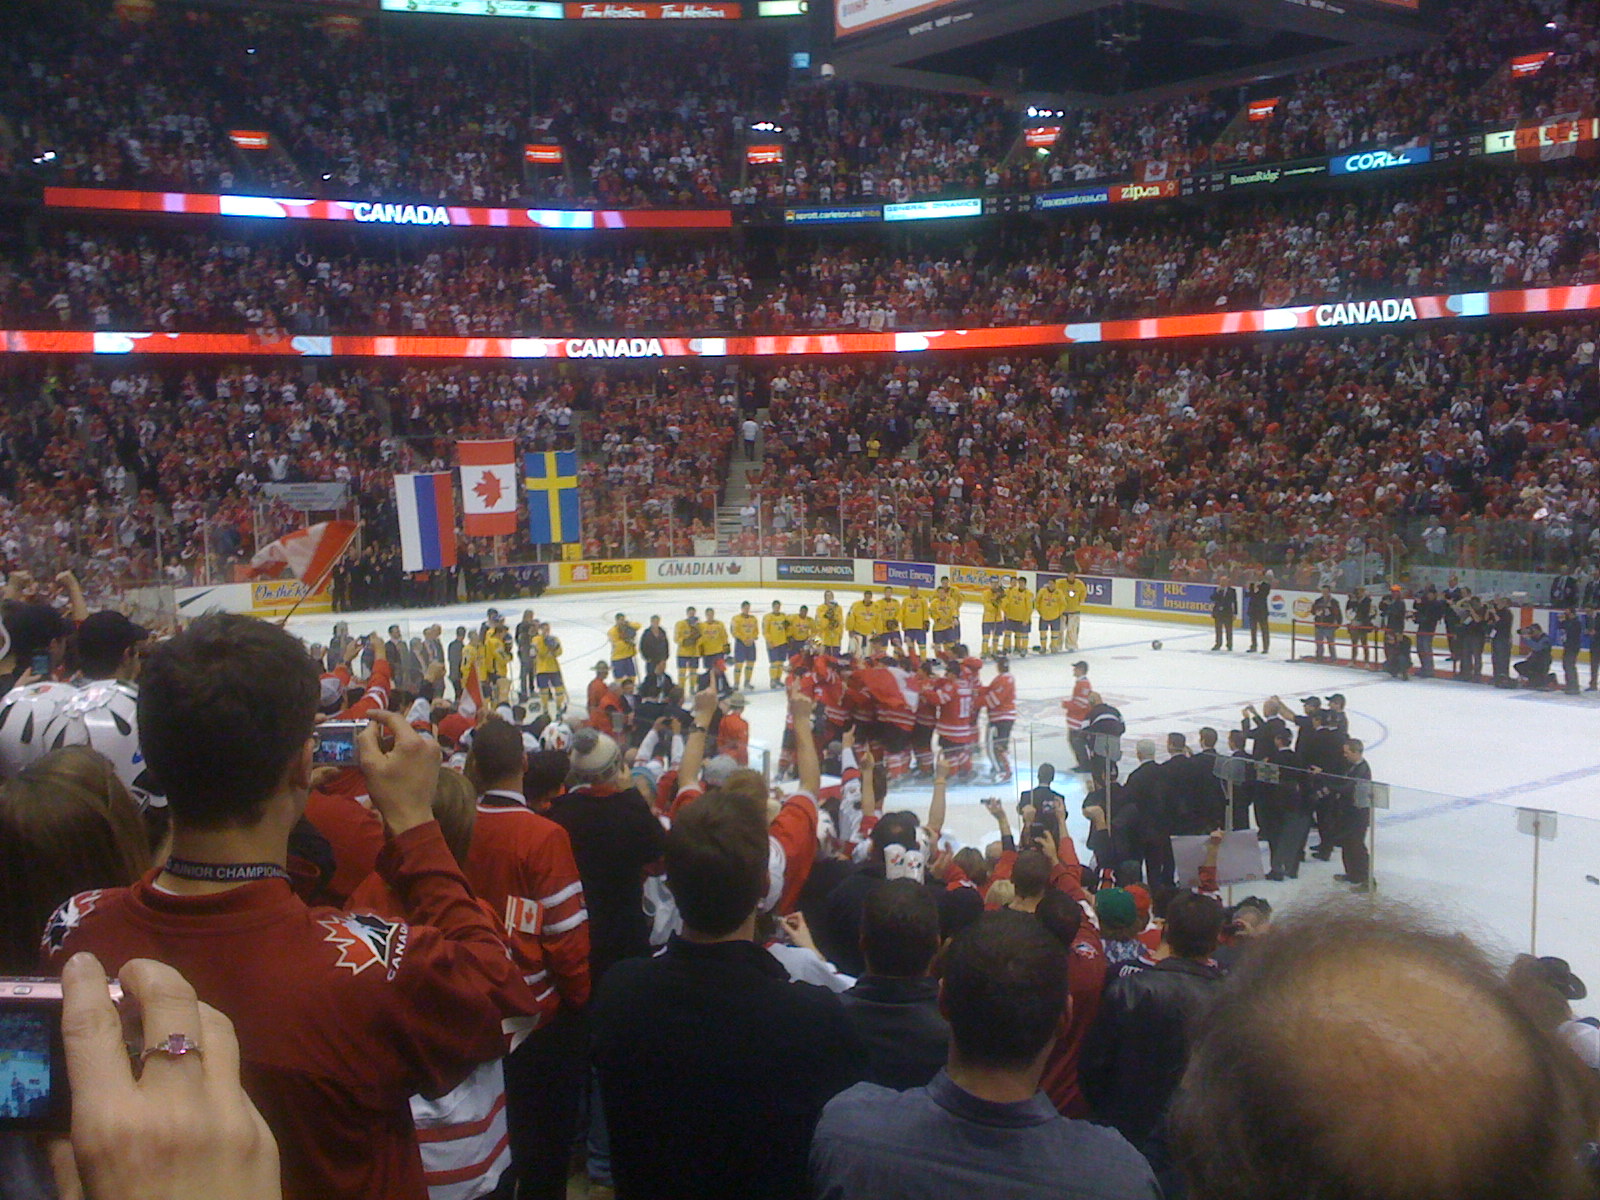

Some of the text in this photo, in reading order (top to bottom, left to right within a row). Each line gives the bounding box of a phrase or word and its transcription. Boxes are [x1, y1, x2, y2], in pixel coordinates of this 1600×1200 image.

[1346, 151, 1411, 171] COREL
[1121, 184, 1160, 200] zip.ca
[353, 202, 450, 226] CANADA
[1315, 298, 1417, 327] CANADA
[565, 338, 664, 358] CANADA
[591, 562, 632, 575] Home
[658, 562, 725, 577] CANADIAN
[888, 567, 933, 583] Direct Energy
[1163, 584, 1187, 596] RBC
